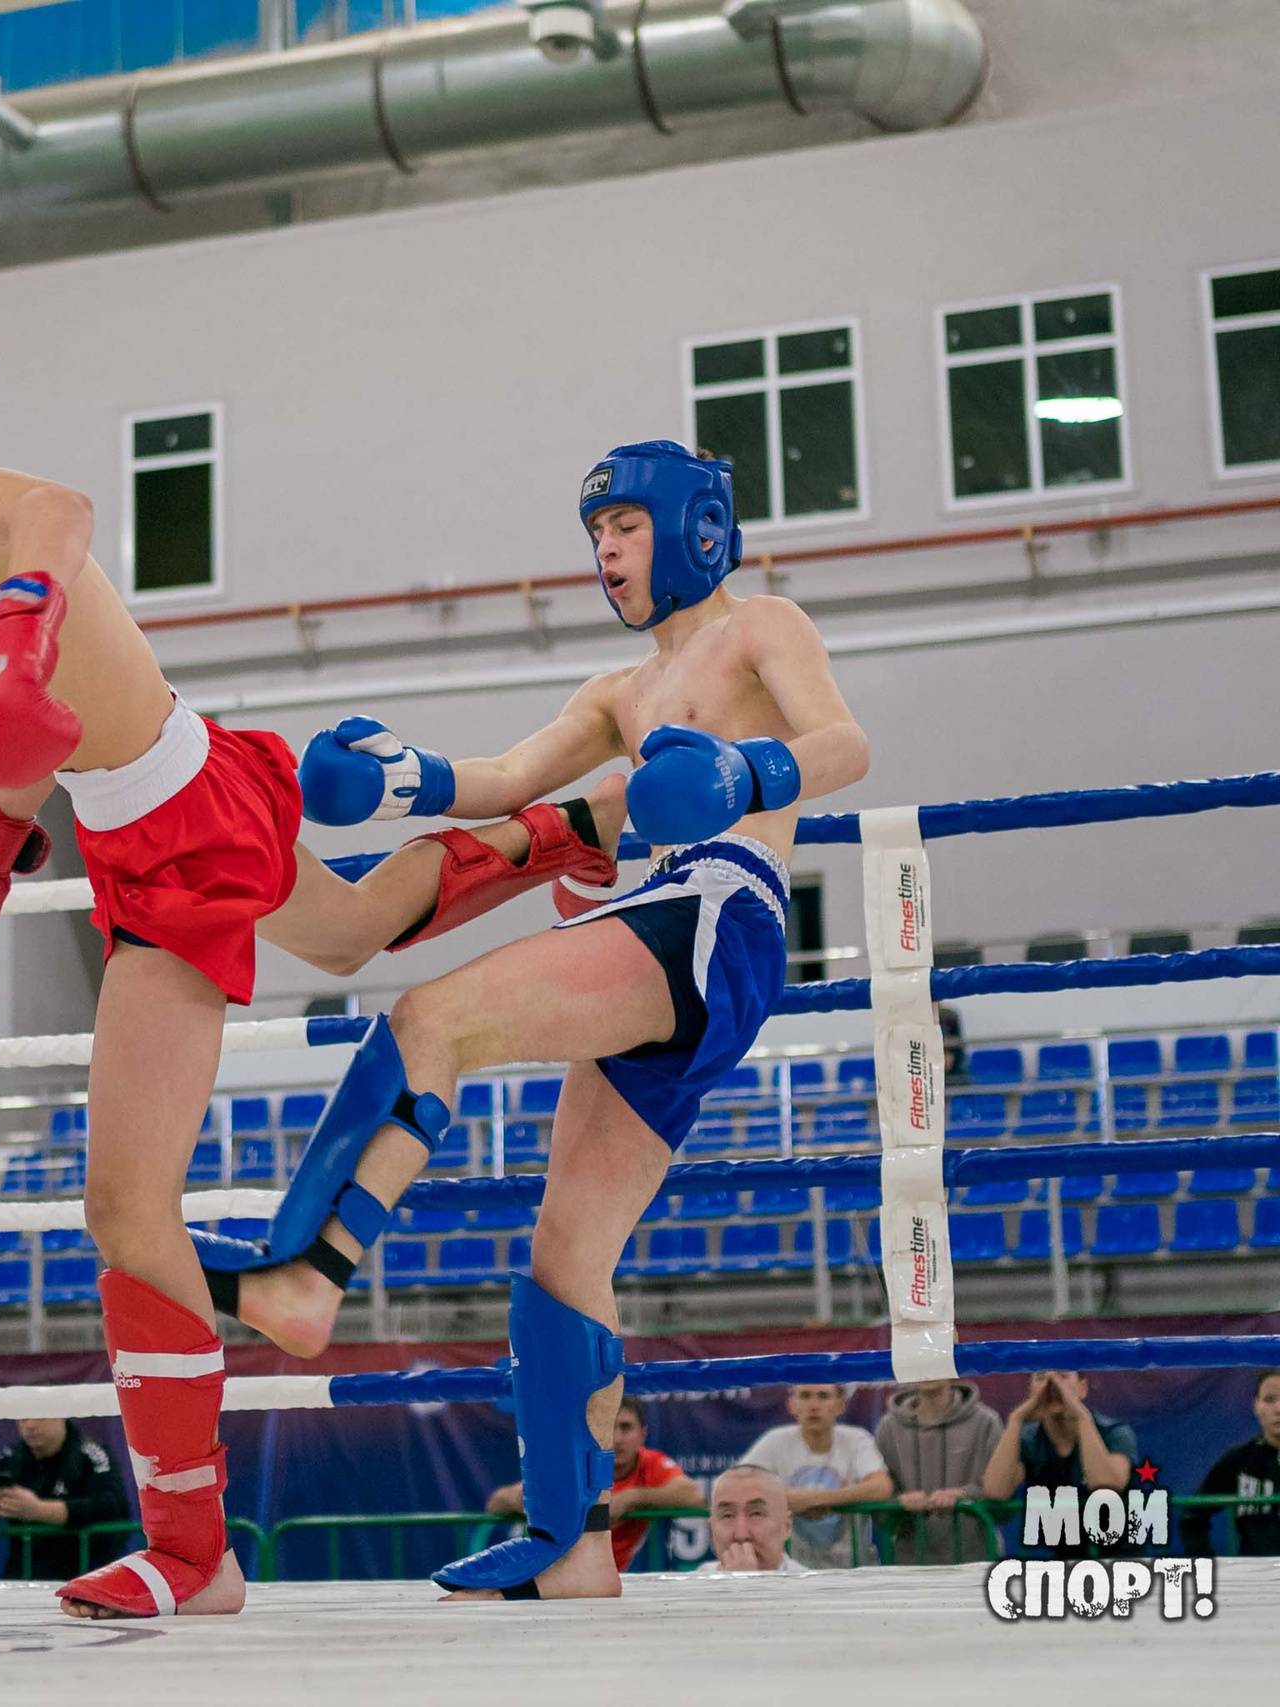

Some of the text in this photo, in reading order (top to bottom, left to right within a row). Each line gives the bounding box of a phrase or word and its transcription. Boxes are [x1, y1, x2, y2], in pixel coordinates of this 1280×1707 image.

[898, 863, 916, 952] Fitnestime
[907, 1040, 925, 1131] Fitnestime
[910, 1216, 926, 1307] Fitnestime
